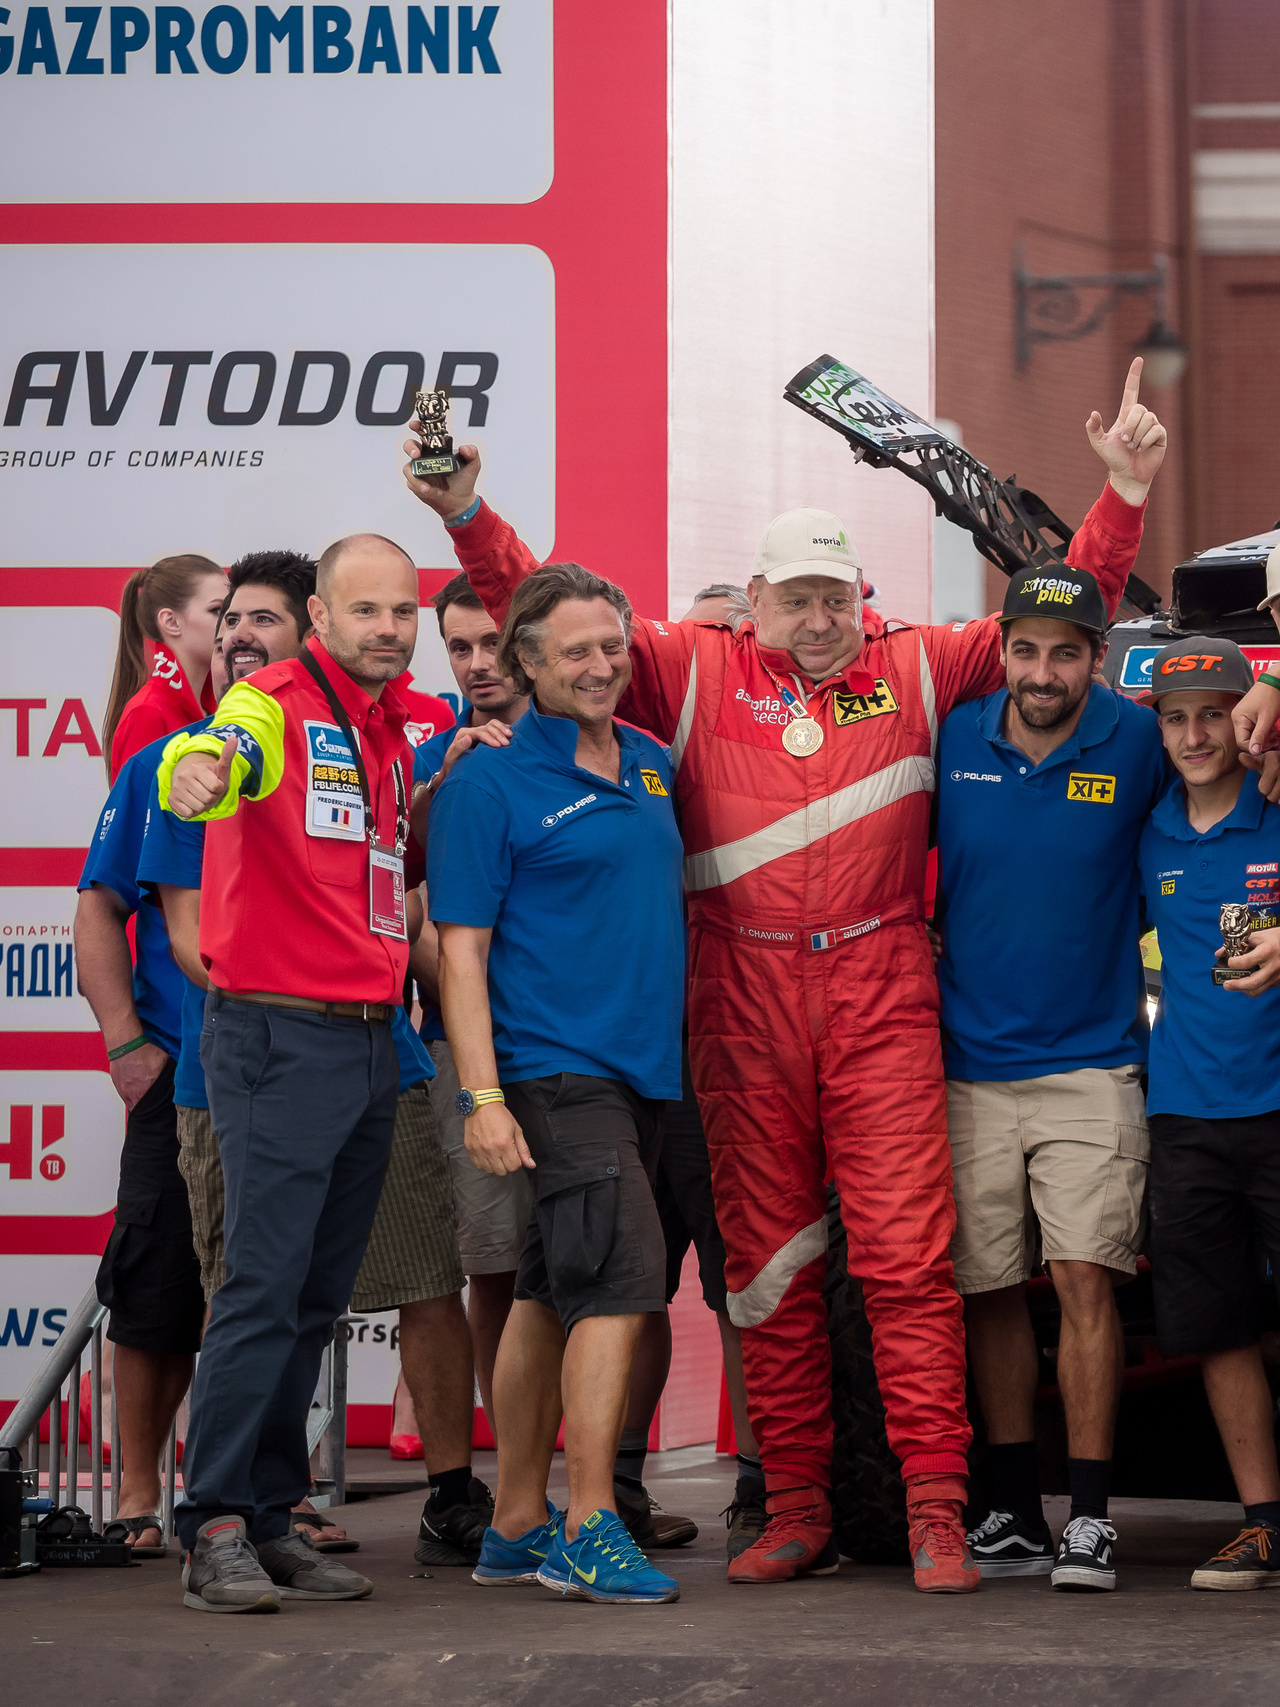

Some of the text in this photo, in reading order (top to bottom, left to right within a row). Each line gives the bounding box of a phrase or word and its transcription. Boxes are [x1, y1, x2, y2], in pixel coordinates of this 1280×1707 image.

[0, 5, 502, 74] AZPROMBANK
[3, 350, 500, 427] AVTODOR
[0, 449, 264, 468] GROUP OF COMPANIES
[812, 536, 841, 547] aspria
[1020, 577, 1082, 596] xtreme
[1036, 587, 1074, 605] plus
[1161, 655, 1223, 675] CST
[0, 698, 104, 757] TA
[963, 772, 1002, 782] POLARIS
[314, 780, 361, 794] FBLIFE.COM
[318, 797, 343, 806] FREDERIC
[557, 793, 597, 819] POLARIS
[1247, 865, 1277, 873] MOTUL
[1245, 879, 1278, 888] CST
[1247, 892, 1280, 902] HOLZ
[739, 926, 794, 941] F. CHAVIGNY
[843, 918, 881, 939] stand21
[0, 943, 86, 997] АДИ
